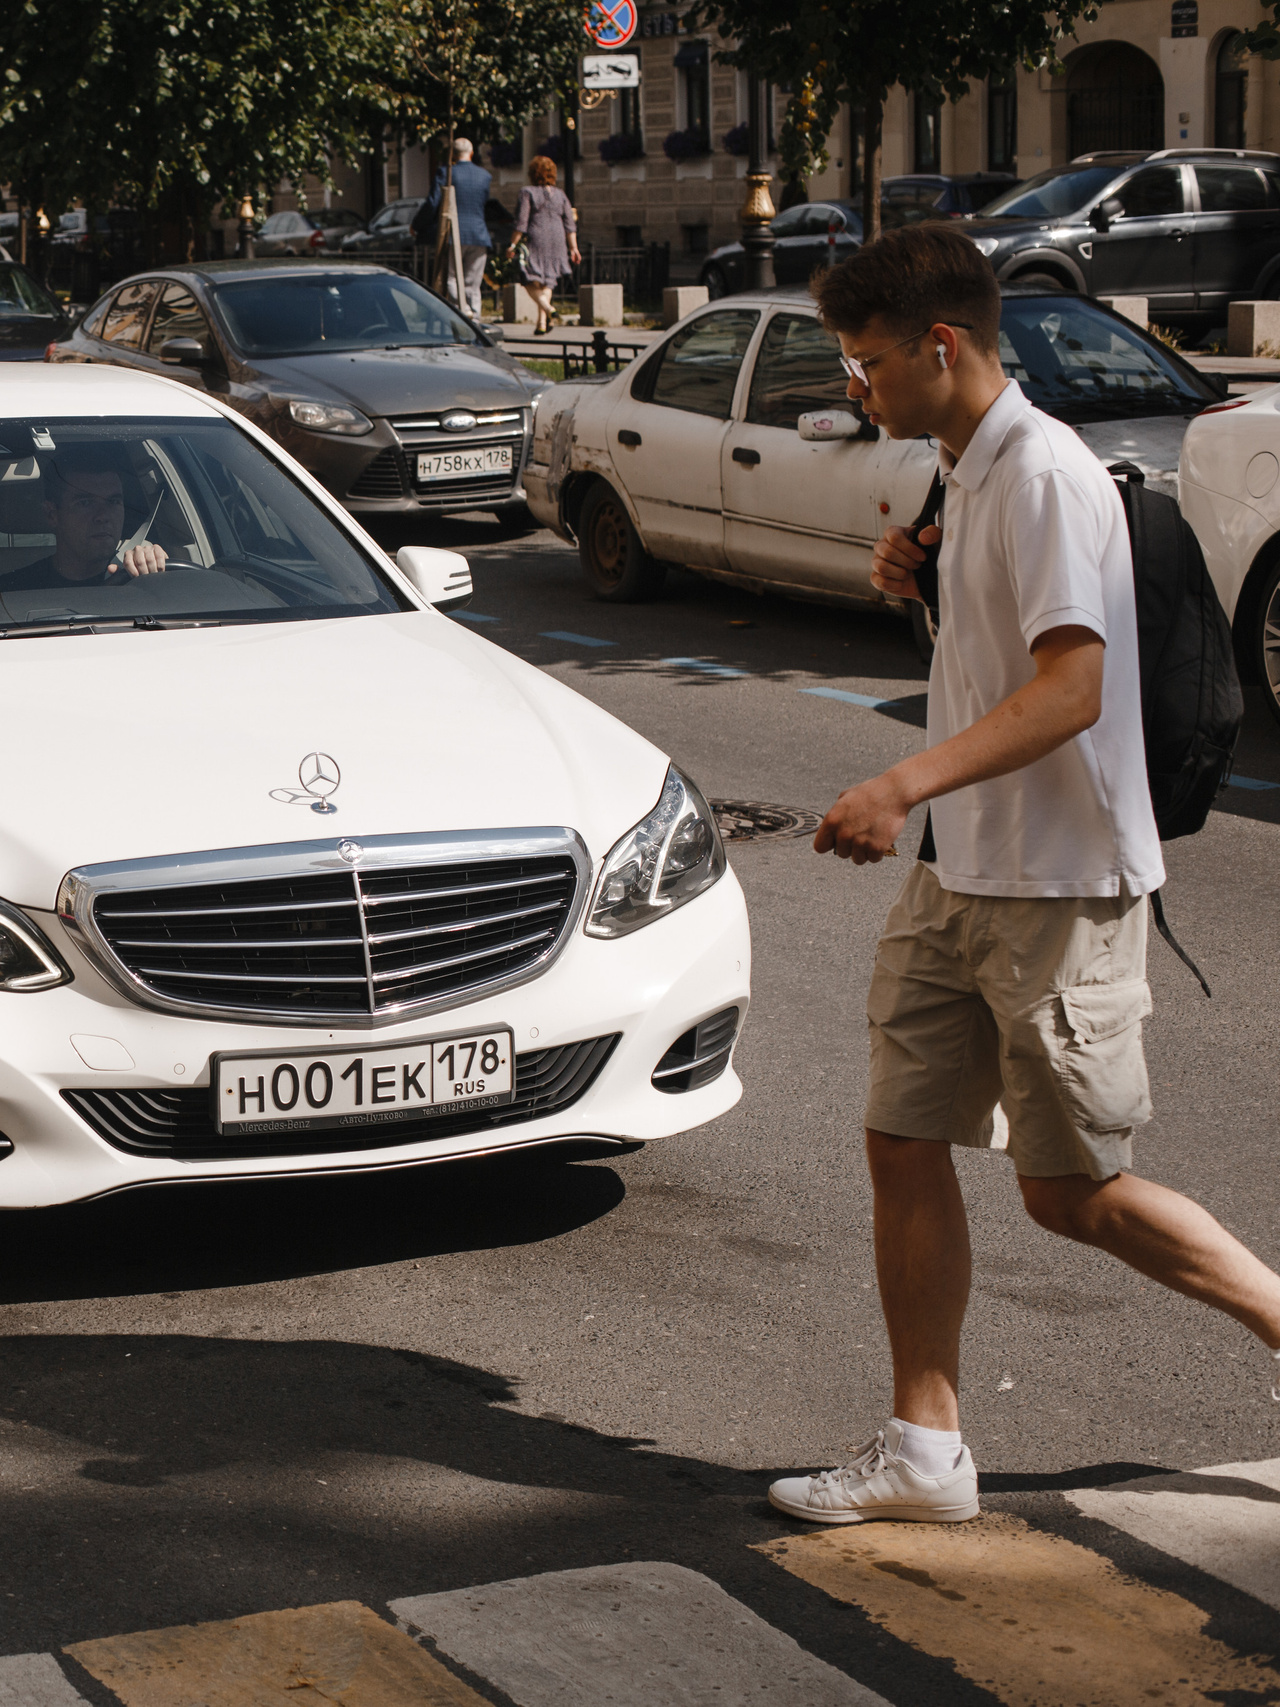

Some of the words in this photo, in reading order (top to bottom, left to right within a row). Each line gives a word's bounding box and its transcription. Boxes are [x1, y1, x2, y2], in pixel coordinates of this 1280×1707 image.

[423, 456, 482, 474] Н758КХ
[486, 450, 508, 463] 178
[238, 1057, 426, 1114] Н001ЕК
[437, 1038, 499, 1081] 178
[453, 1079, 486, 1097] RUS
[238, 1119, 311, 1133] Mercedes-Benz
